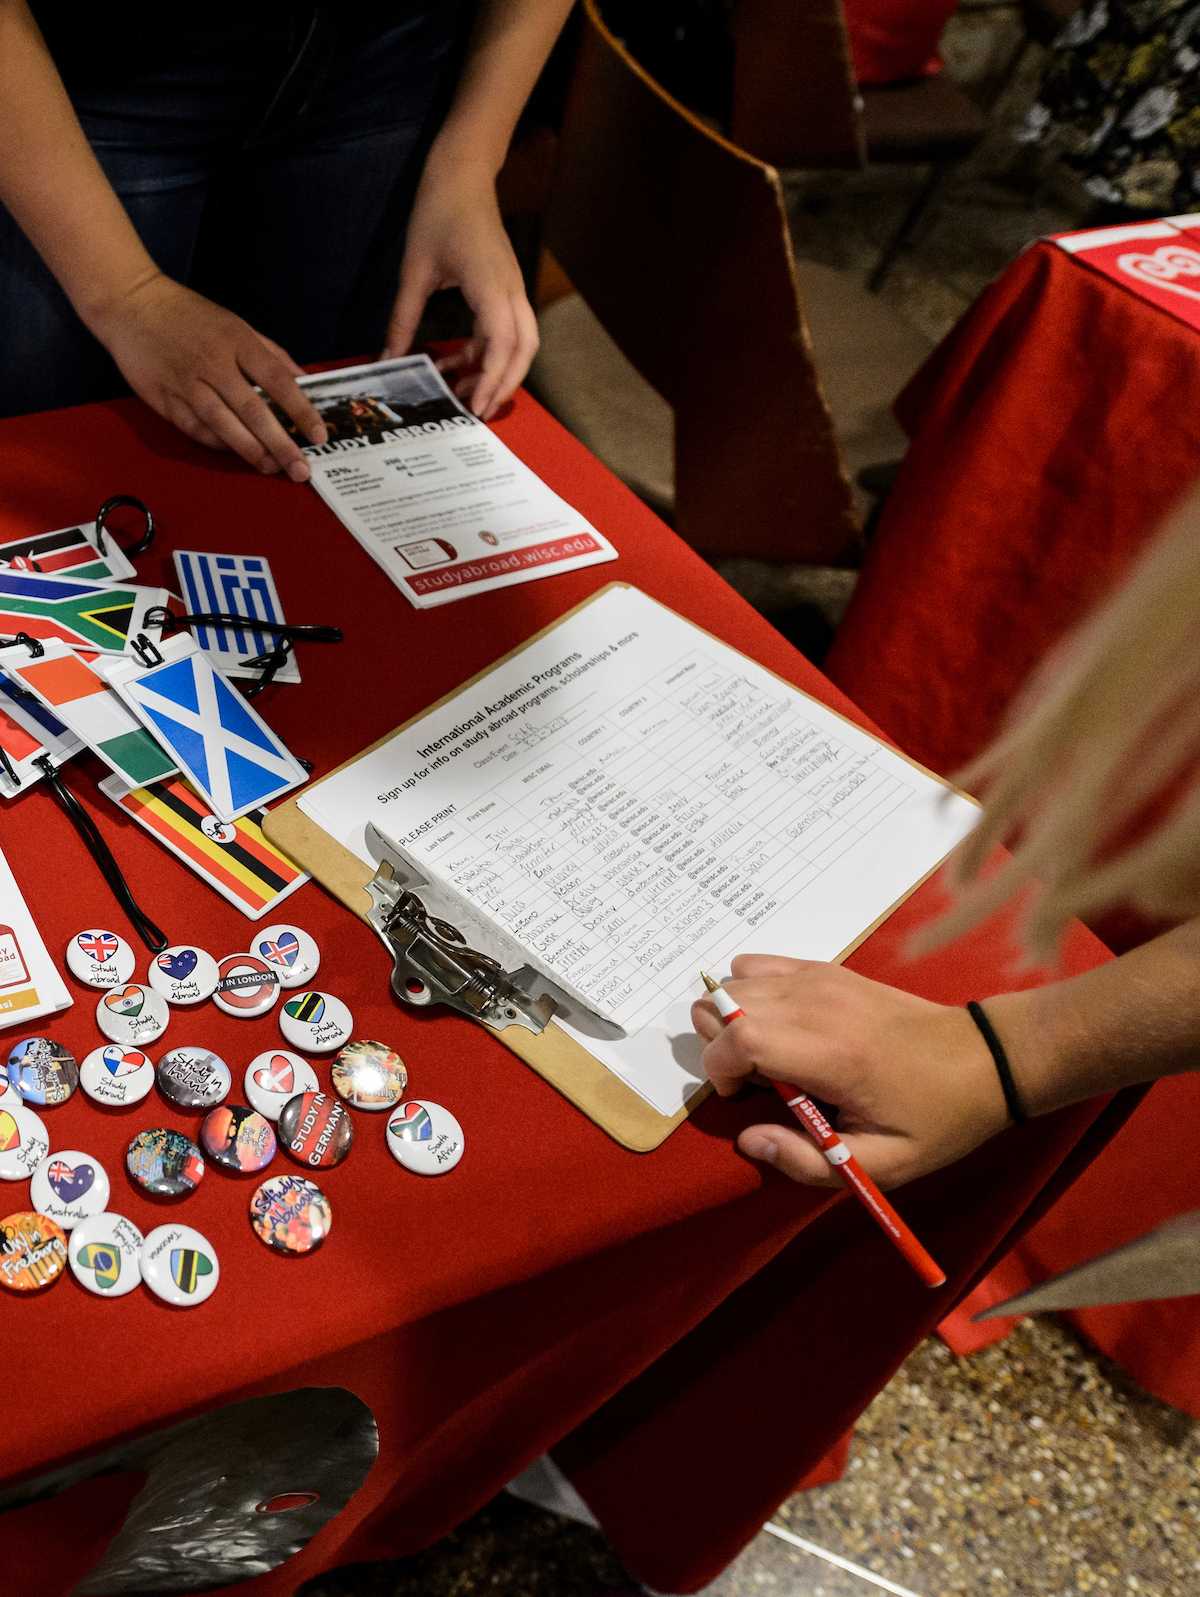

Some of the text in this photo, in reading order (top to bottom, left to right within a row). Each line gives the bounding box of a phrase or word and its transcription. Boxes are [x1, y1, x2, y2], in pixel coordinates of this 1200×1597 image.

[302, 433, 372, 458] STUDY
[382, 413, 477, 446] ABROAD
[414, 535, 597, 592] studyabroad.wisc.edu
[377, 787, 402, 803] Sign
[401, 778, 416, 788] up
[413, 767, 429, 779] for
[429, 755, 449, 769] info
[449, 746, 463, 756] on
[462, 729, 489, 748] study
[487, 709, 518, 731] abroad
[517, 685, 558, 714] programs,
[558, 651, 610, 685] scholarships
[616, 631, 639, 646] more
[416, 653, 581, 758] International Academic Programs
[398, 803, 456, 846] PLEASE PRINT
[466, 801, 496, 822] First Name
[424, 830, 454, 852] Last Name
[90, 974, 120, 983] Abroad
[91, 964, 117, 976] Study
[226, 978, 236, 986] IN
[238, 973, 275, 984] LONDON
[588, 973, 624, 1003] Larsen
[634, 941, 663, 965] Anna
[171, 981, 198, 991] Study
[172, 991, 200, 1000] Abroad
[310, 1021, 338, 1035] Study
[316, 1028, 344, 1044] Abroad
[168, 1064, 209, 1096] Ireland
[173, 1053, 222, 1088] Study in
[94, 1086, 125, 1101] Abroad
[100, 1077, 127, 1094] Study
[291, 1092, 327, 1153] STUDY IN
[308, 1101, 343, 1165] GERMANY
[800, 1102, 832, 1138] abroad
[428, 1134, 449, 1154] South
[437, 1142, 458, 1164] Africa
[255, 1176, 302, 1214] Study
[45, 1204, 89, 1219] Australia
[269, 1186, 317, 1232] Abroad
[2, 1229, 43, 1255] UW in
[1, 1239, 66, 1279] Freiburg
